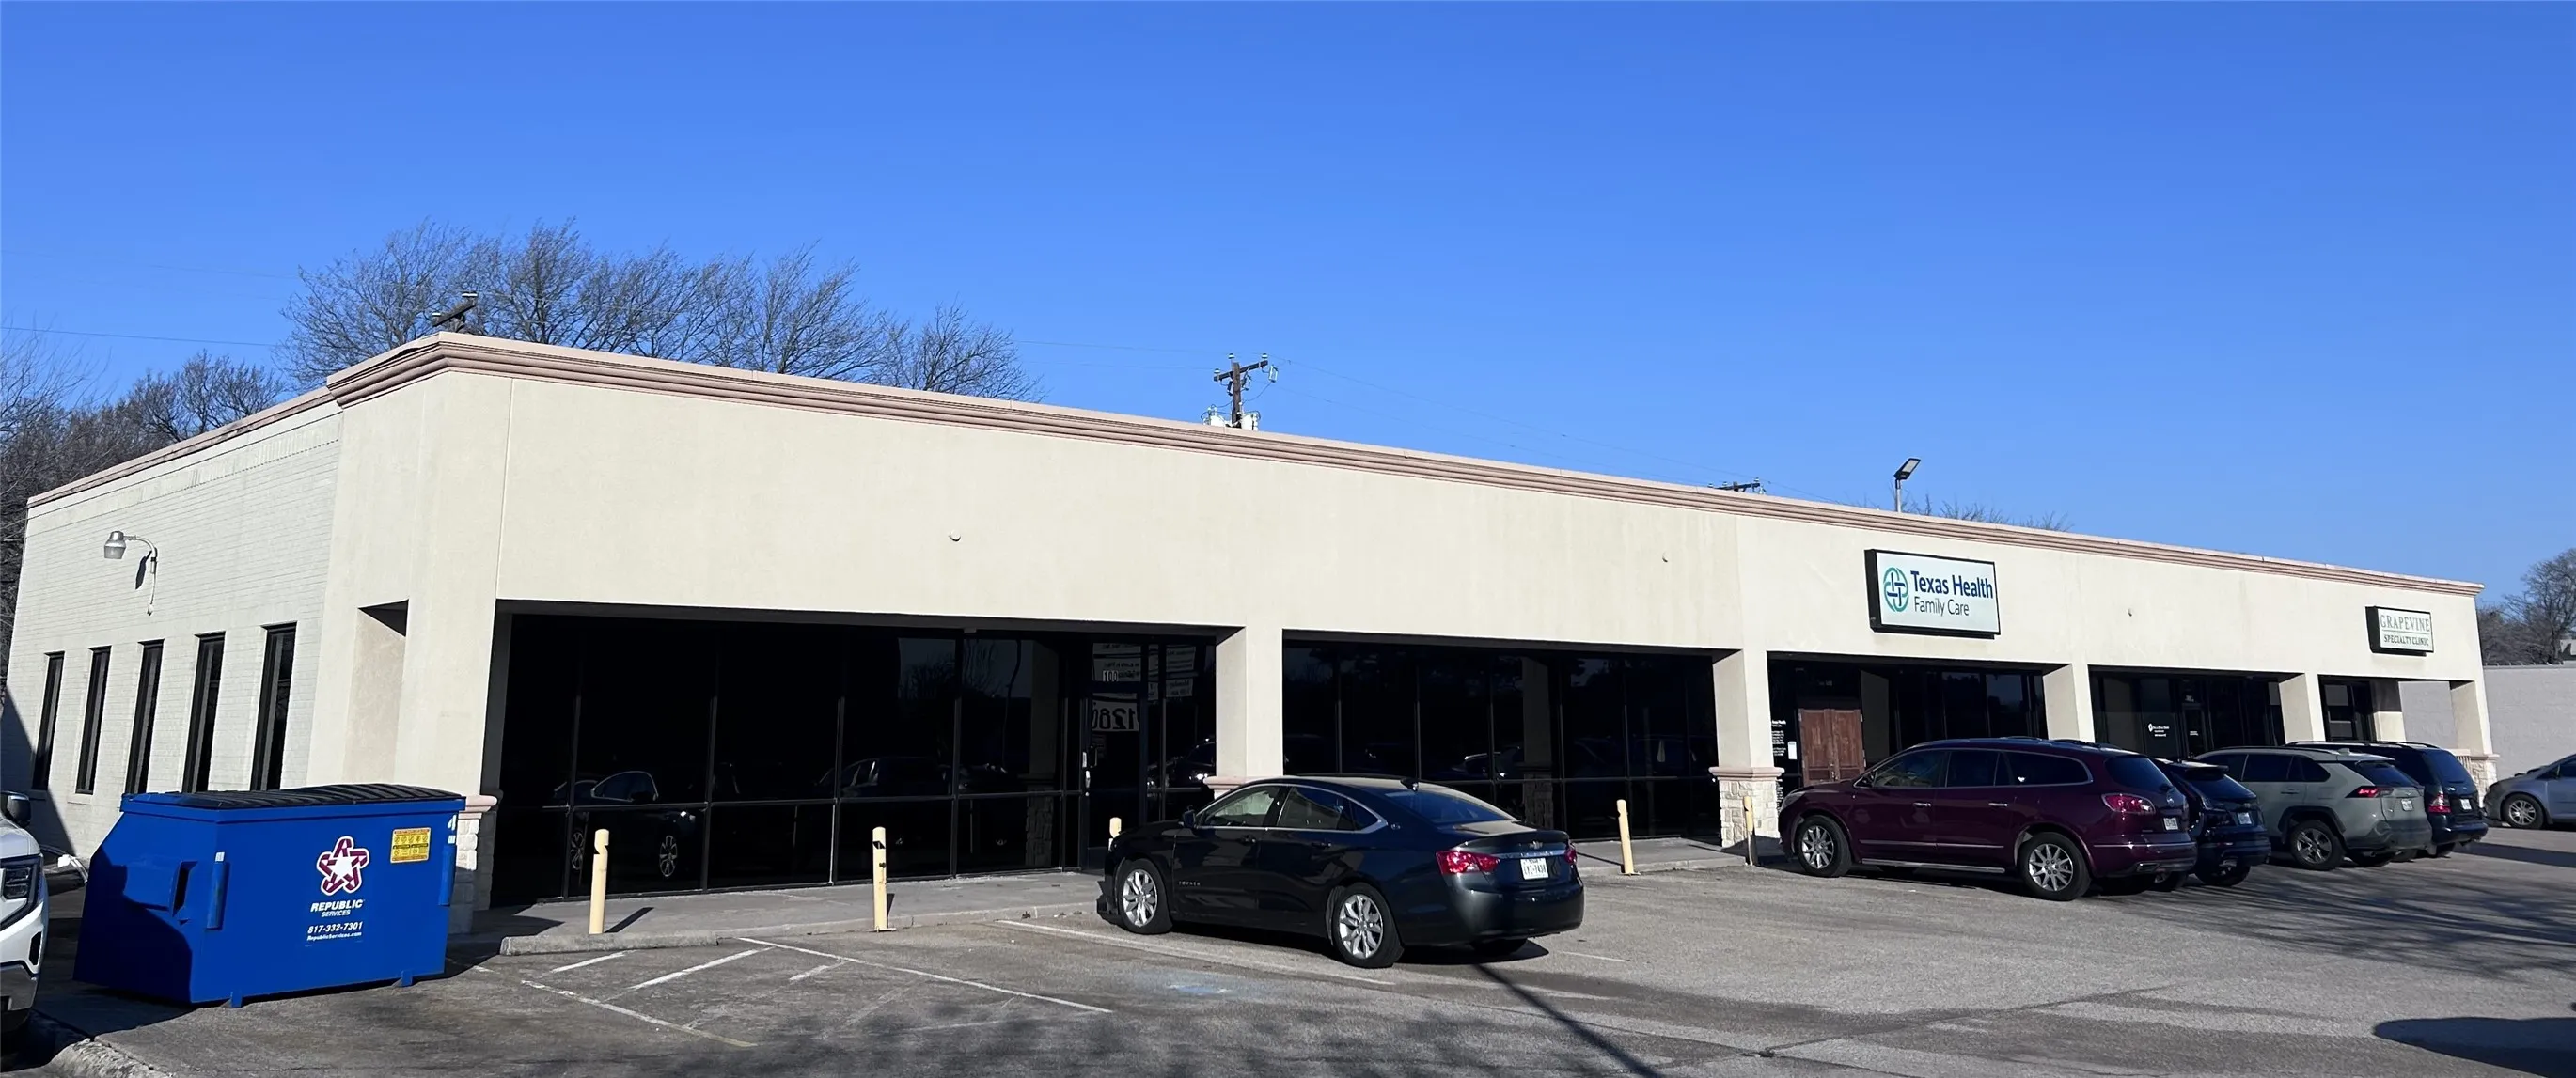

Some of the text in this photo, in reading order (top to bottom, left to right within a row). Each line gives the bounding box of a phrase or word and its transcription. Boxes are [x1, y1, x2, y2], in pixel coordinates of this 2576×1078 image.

[1910, 570, 1993, 599] Texas Health
[1914, 596, 1970, 617] Family Care
[2380, 615, 2430, 632] GRAPEVINE
[2383, 634, 2429, 647] SPECIALTY CLINIC
[310, 898, 364, 913] REPUBLIC
[321, 909, 352, 918] SERVICES
[307, 921, 364, 934] 817-332-7301
